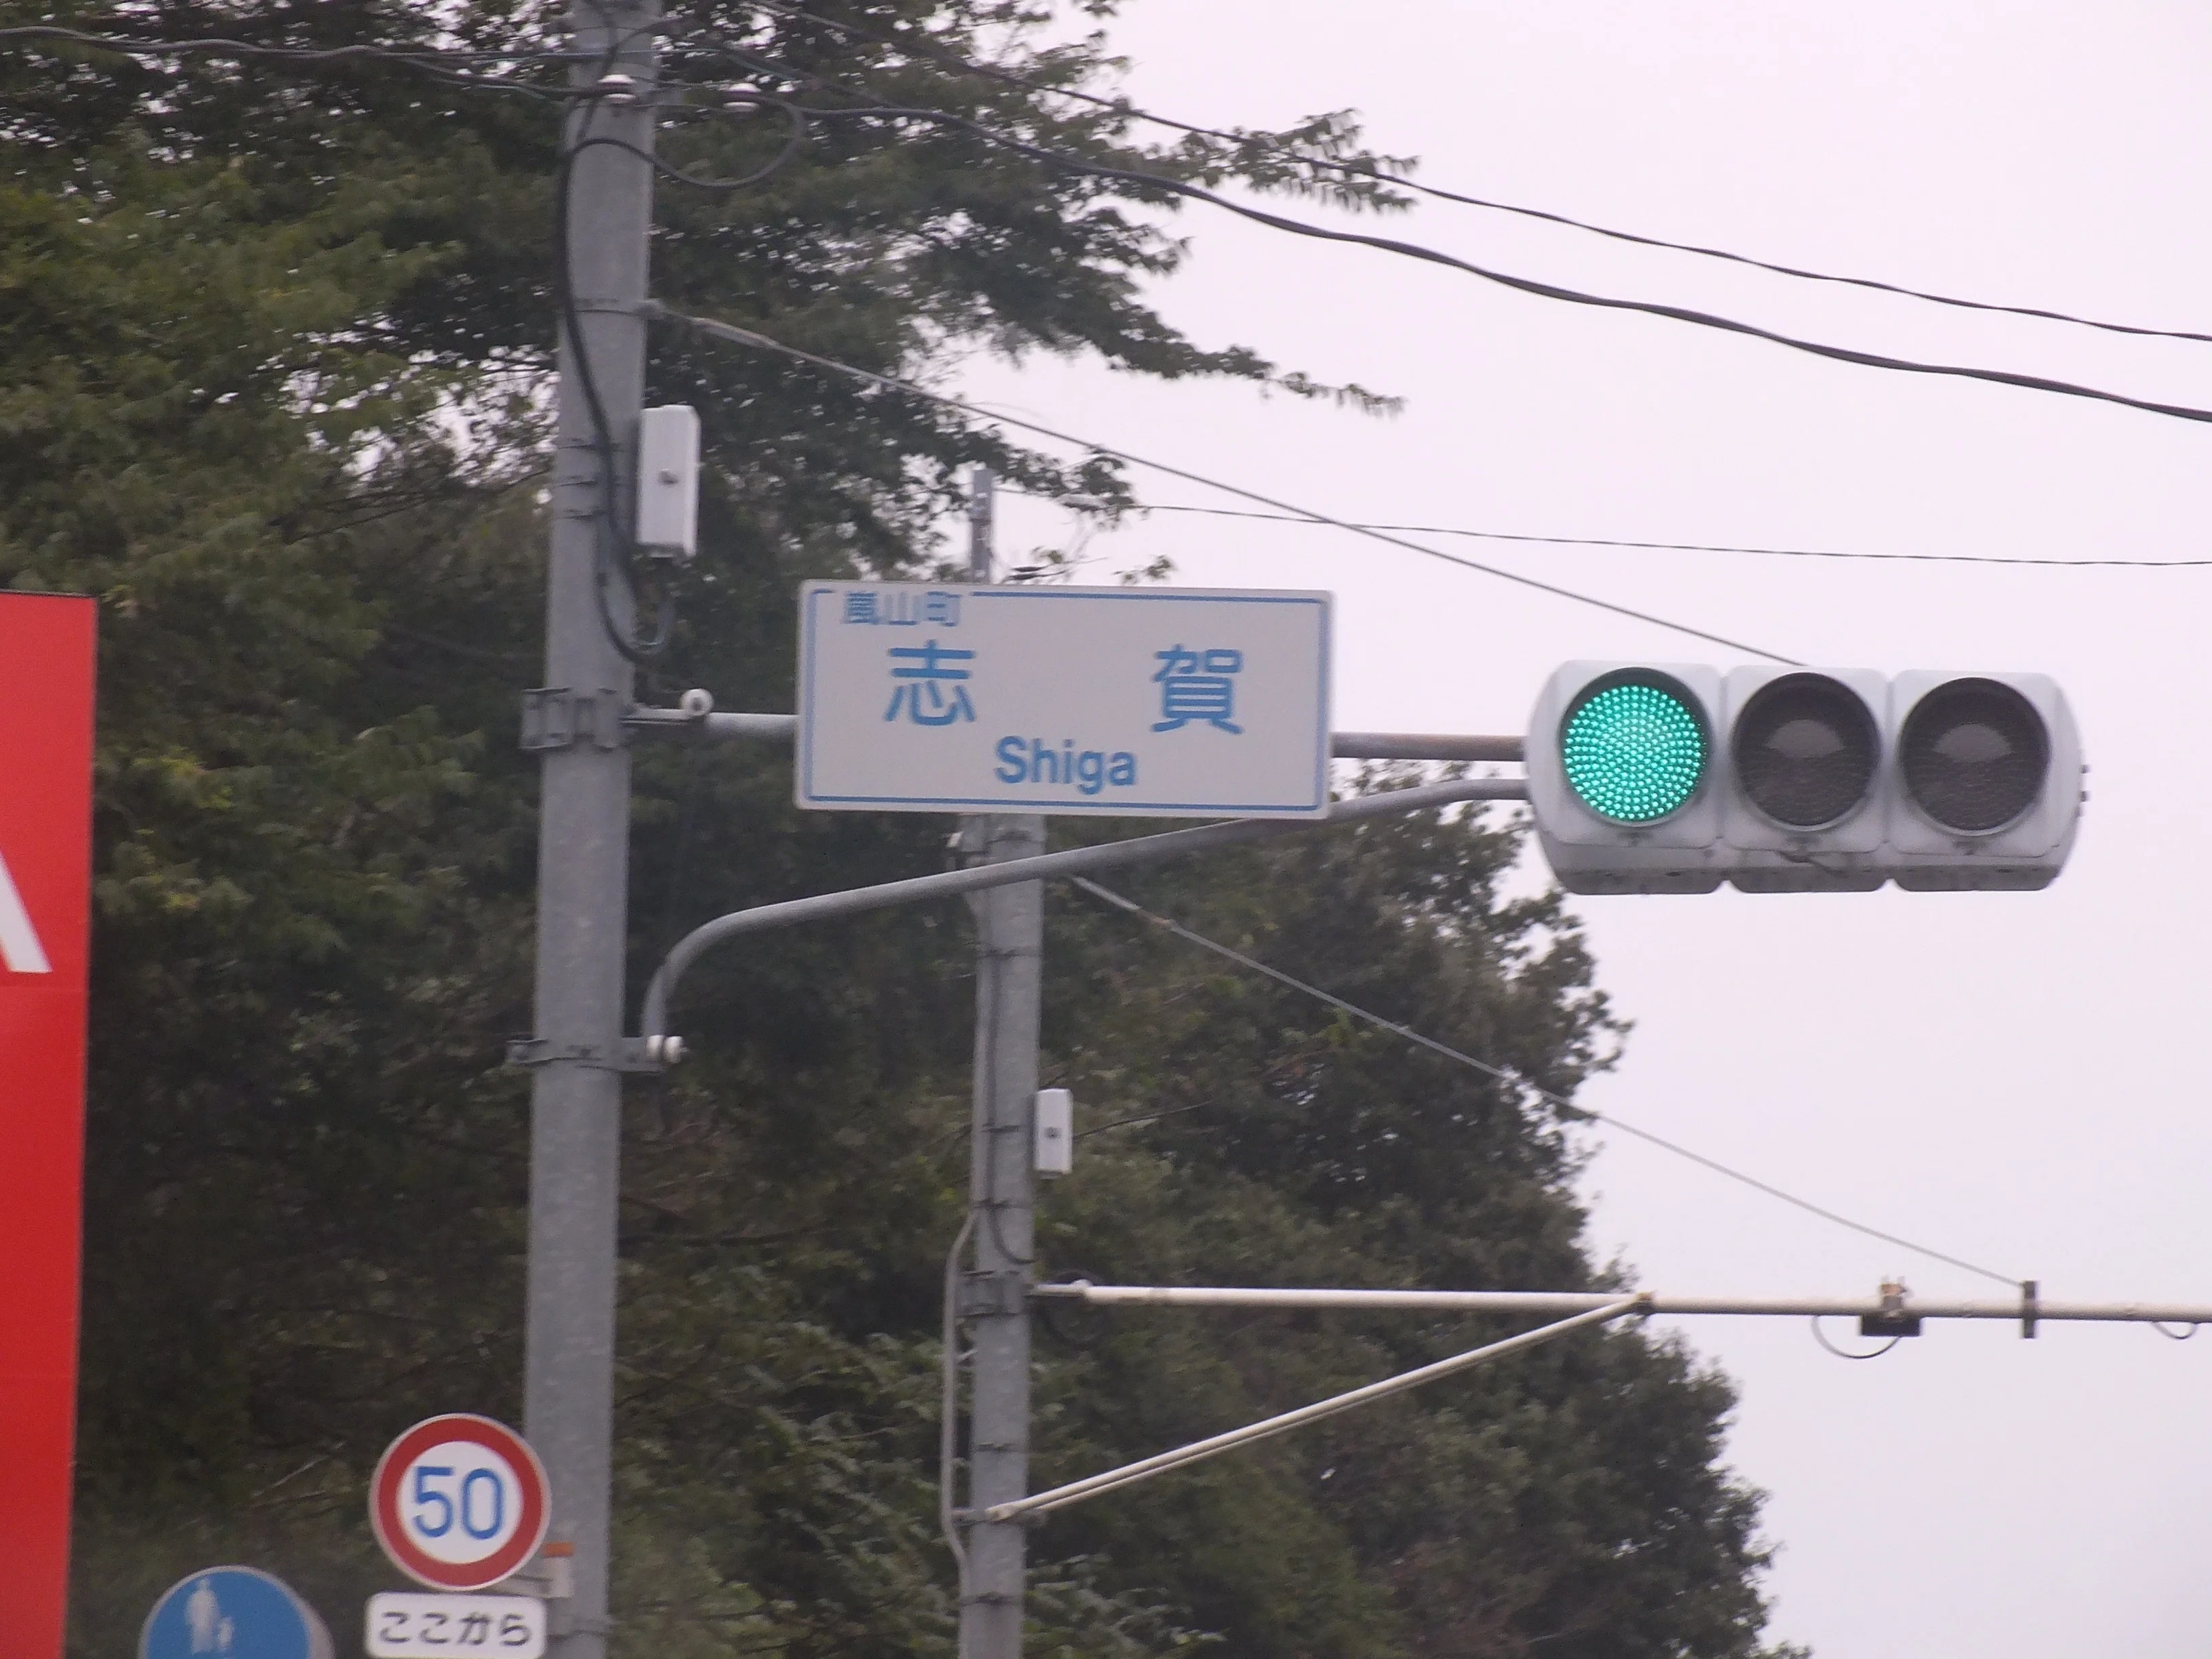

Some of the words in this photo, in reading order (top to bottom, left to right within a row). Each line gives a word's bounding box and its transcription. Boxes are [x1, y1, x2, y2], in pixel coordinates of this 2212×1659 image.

[844, 591, 962, 626] 嵐山町
[994, 735, 1138, 796] Shiga
[412, 1466, 504, 1539] 50
[379, 1610, 532, 1646] ここから
